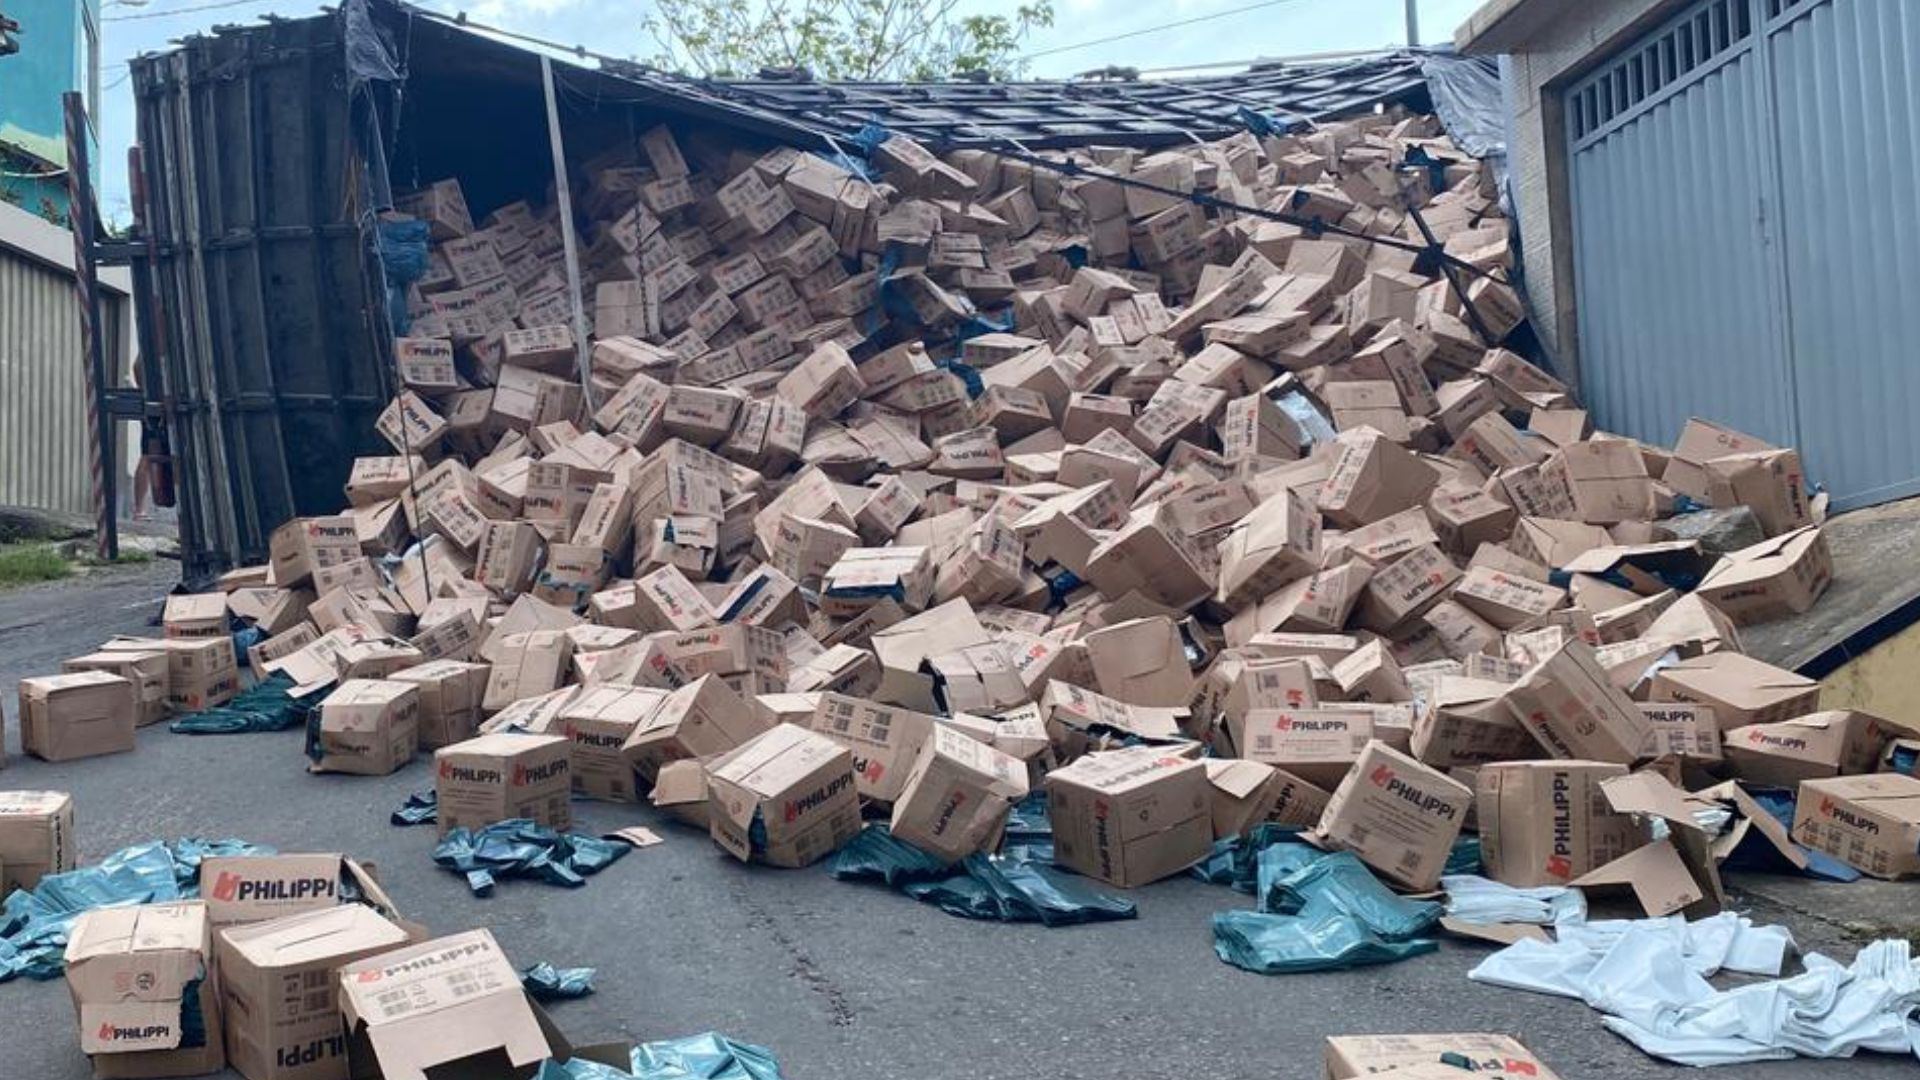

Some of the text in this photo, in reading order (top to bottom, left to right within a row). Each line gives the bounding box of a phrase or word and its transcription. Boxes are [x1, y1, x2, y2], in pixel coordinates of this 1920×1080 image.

[1292, 721, 1348, 731] PHILIPPI
[576, 732, 625, 748] PHILIPP
[453, 767, 500, 784] PHILIPPI
[799, 770, 854, 812] PHILIPPI
[1387, 780, 1456, 820] PHILIPPI
[1554, 771, 1570, 856] PHILIPPI
[238, 879, 334, 901] PHILIPPI
[113, 1026, 169, 1040] PHILIPPI
[277, 1035, 343, 1067] ILIPPI
